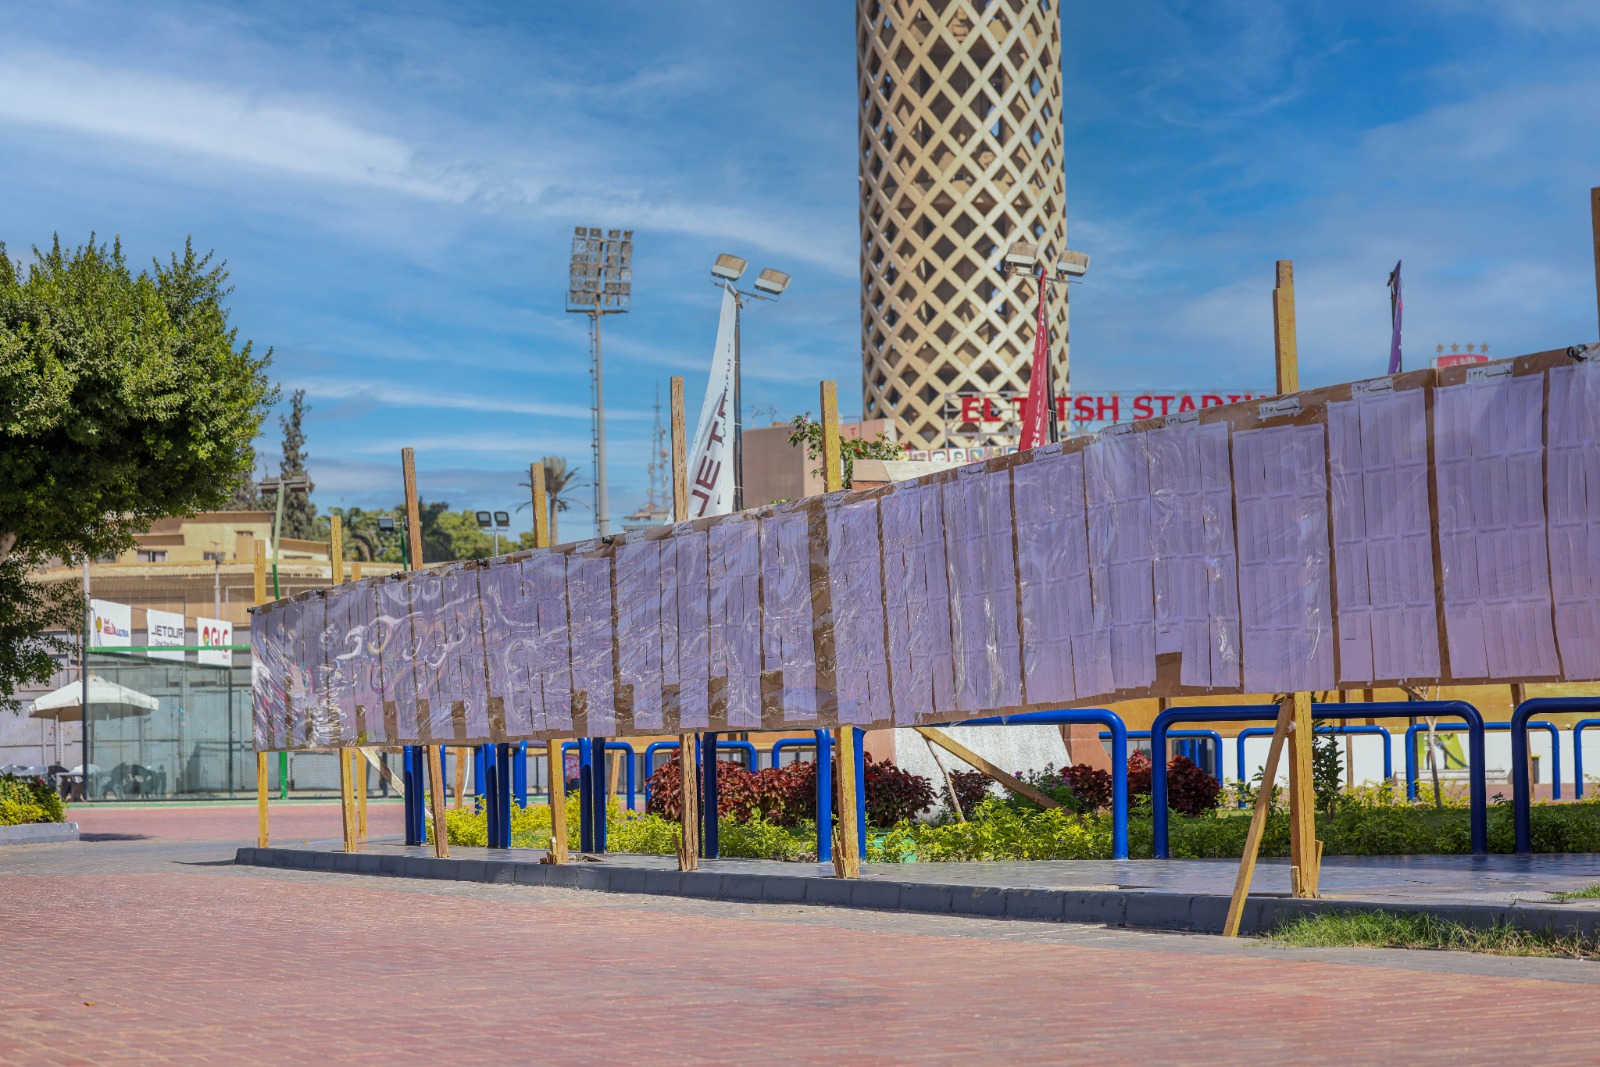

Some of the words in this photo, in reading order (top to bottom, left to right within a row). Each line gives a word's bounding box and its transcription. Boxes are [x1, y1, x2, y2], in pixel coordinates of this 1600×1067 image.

[961, 397, 1001, 422] EL
[1012, 395, 1120, 422] TTSH
[151, 625, 184, 639] JETOUR
